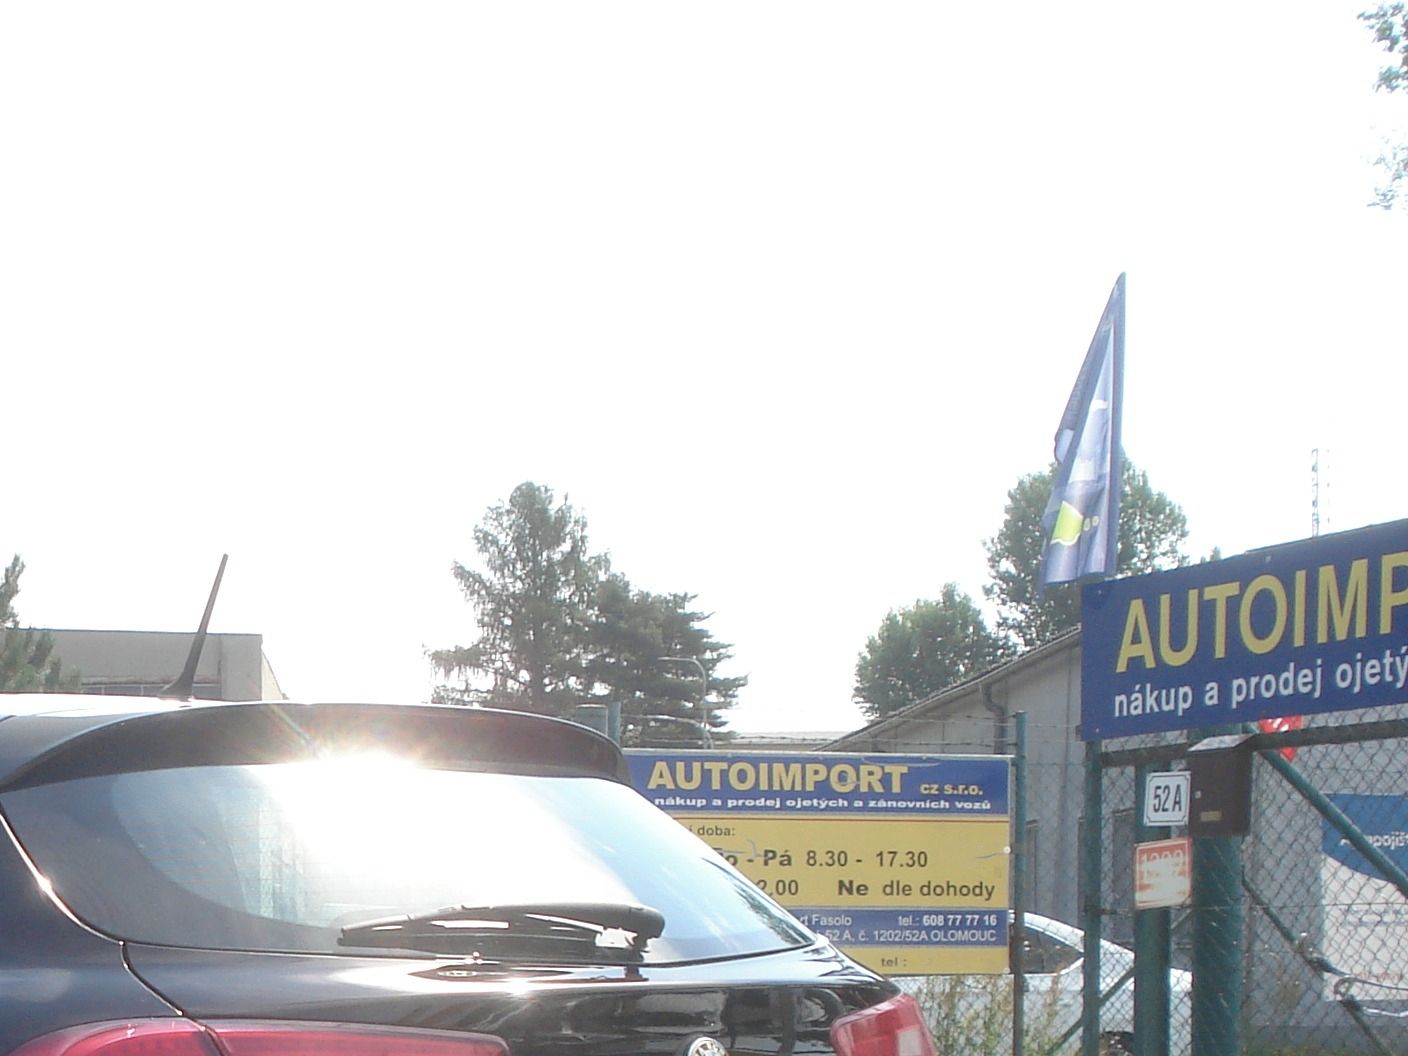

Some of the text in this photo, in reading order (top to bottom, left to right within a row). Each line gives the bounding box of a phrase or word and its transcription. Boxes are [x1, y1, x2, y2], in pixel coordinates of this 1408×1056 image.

[1115, 551, 1408, 673] AUTOIMP
[1114, 683, 1192, 717] nákup
[1204, 681, 1219, 706] a
[1231, 657, 1323, 708] prodej
[647, 760, 984, 796] AUTOIMPORT cz s.r.o.
[654, 796, 707, 807] nákup
[727, 797, 781, 808] prodej
[785, 797, 848, 809] ojetých
[868, 799, 950, 809] zánovních
[955, 800, 991, 810] vozů
[697, 825, 736, 836] doba:
[763, 850, 792, 867] Pá
[806, 850, 848, 867] 8.30
[875, 851, 928, 867] 17.30
[837, 880, 869, 896] Ne
[882, 880, 912, 896] dle
[919, 881, 995, 900] dohody
[812, 914, 852, 926] Fasolo
[922, 915, 944, 926] 608
[946, 915, 962, 926] 77
[965, 915, 980, 926] 77
[983, 915, 997, 926] 16
[873, 930, 928, 941] 1202/52A
[930, 930, 997, 941] OLOMOUC
